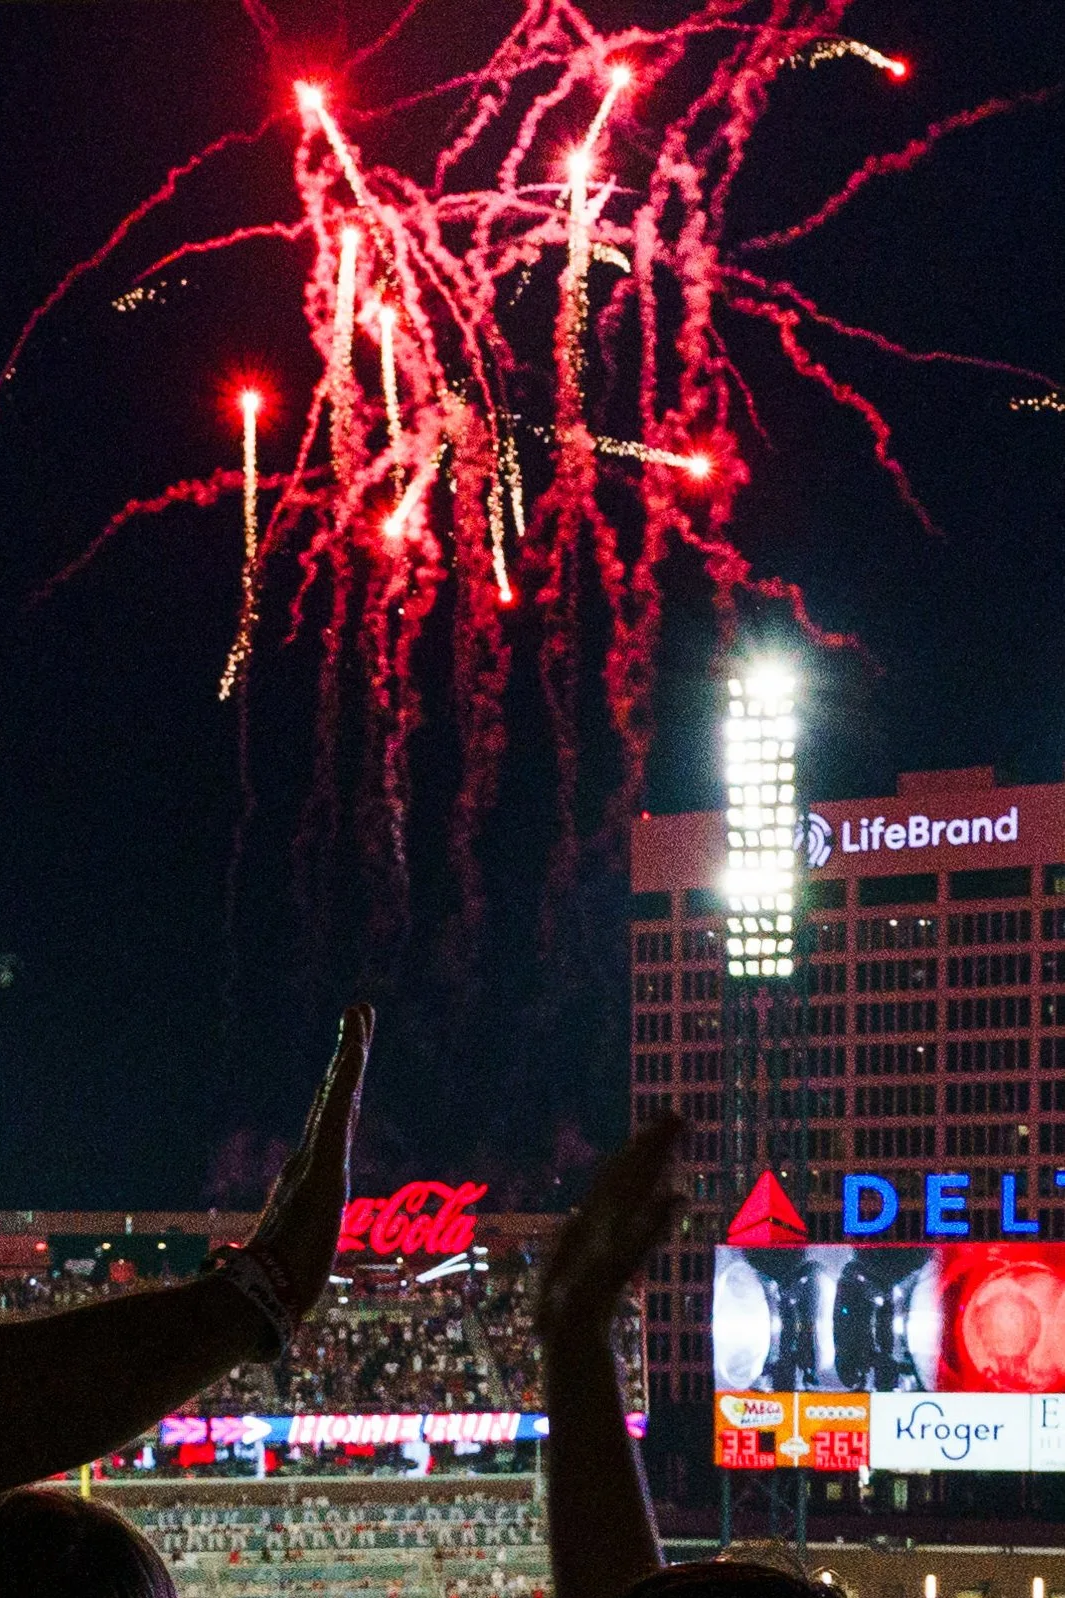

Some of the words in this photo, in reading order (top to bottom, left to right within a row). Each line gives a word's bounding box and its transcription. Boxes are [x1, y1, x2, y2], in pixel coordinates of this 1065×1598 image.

[841, 806, 1019, 854] LifeBrand
[842, 1173, 1065, 1236] DEL
[288, 1414, 423, 1443] HOME
[424, 1413, 521, 1441] RUN
[896, 1401, 1005, 1460] Kroger
